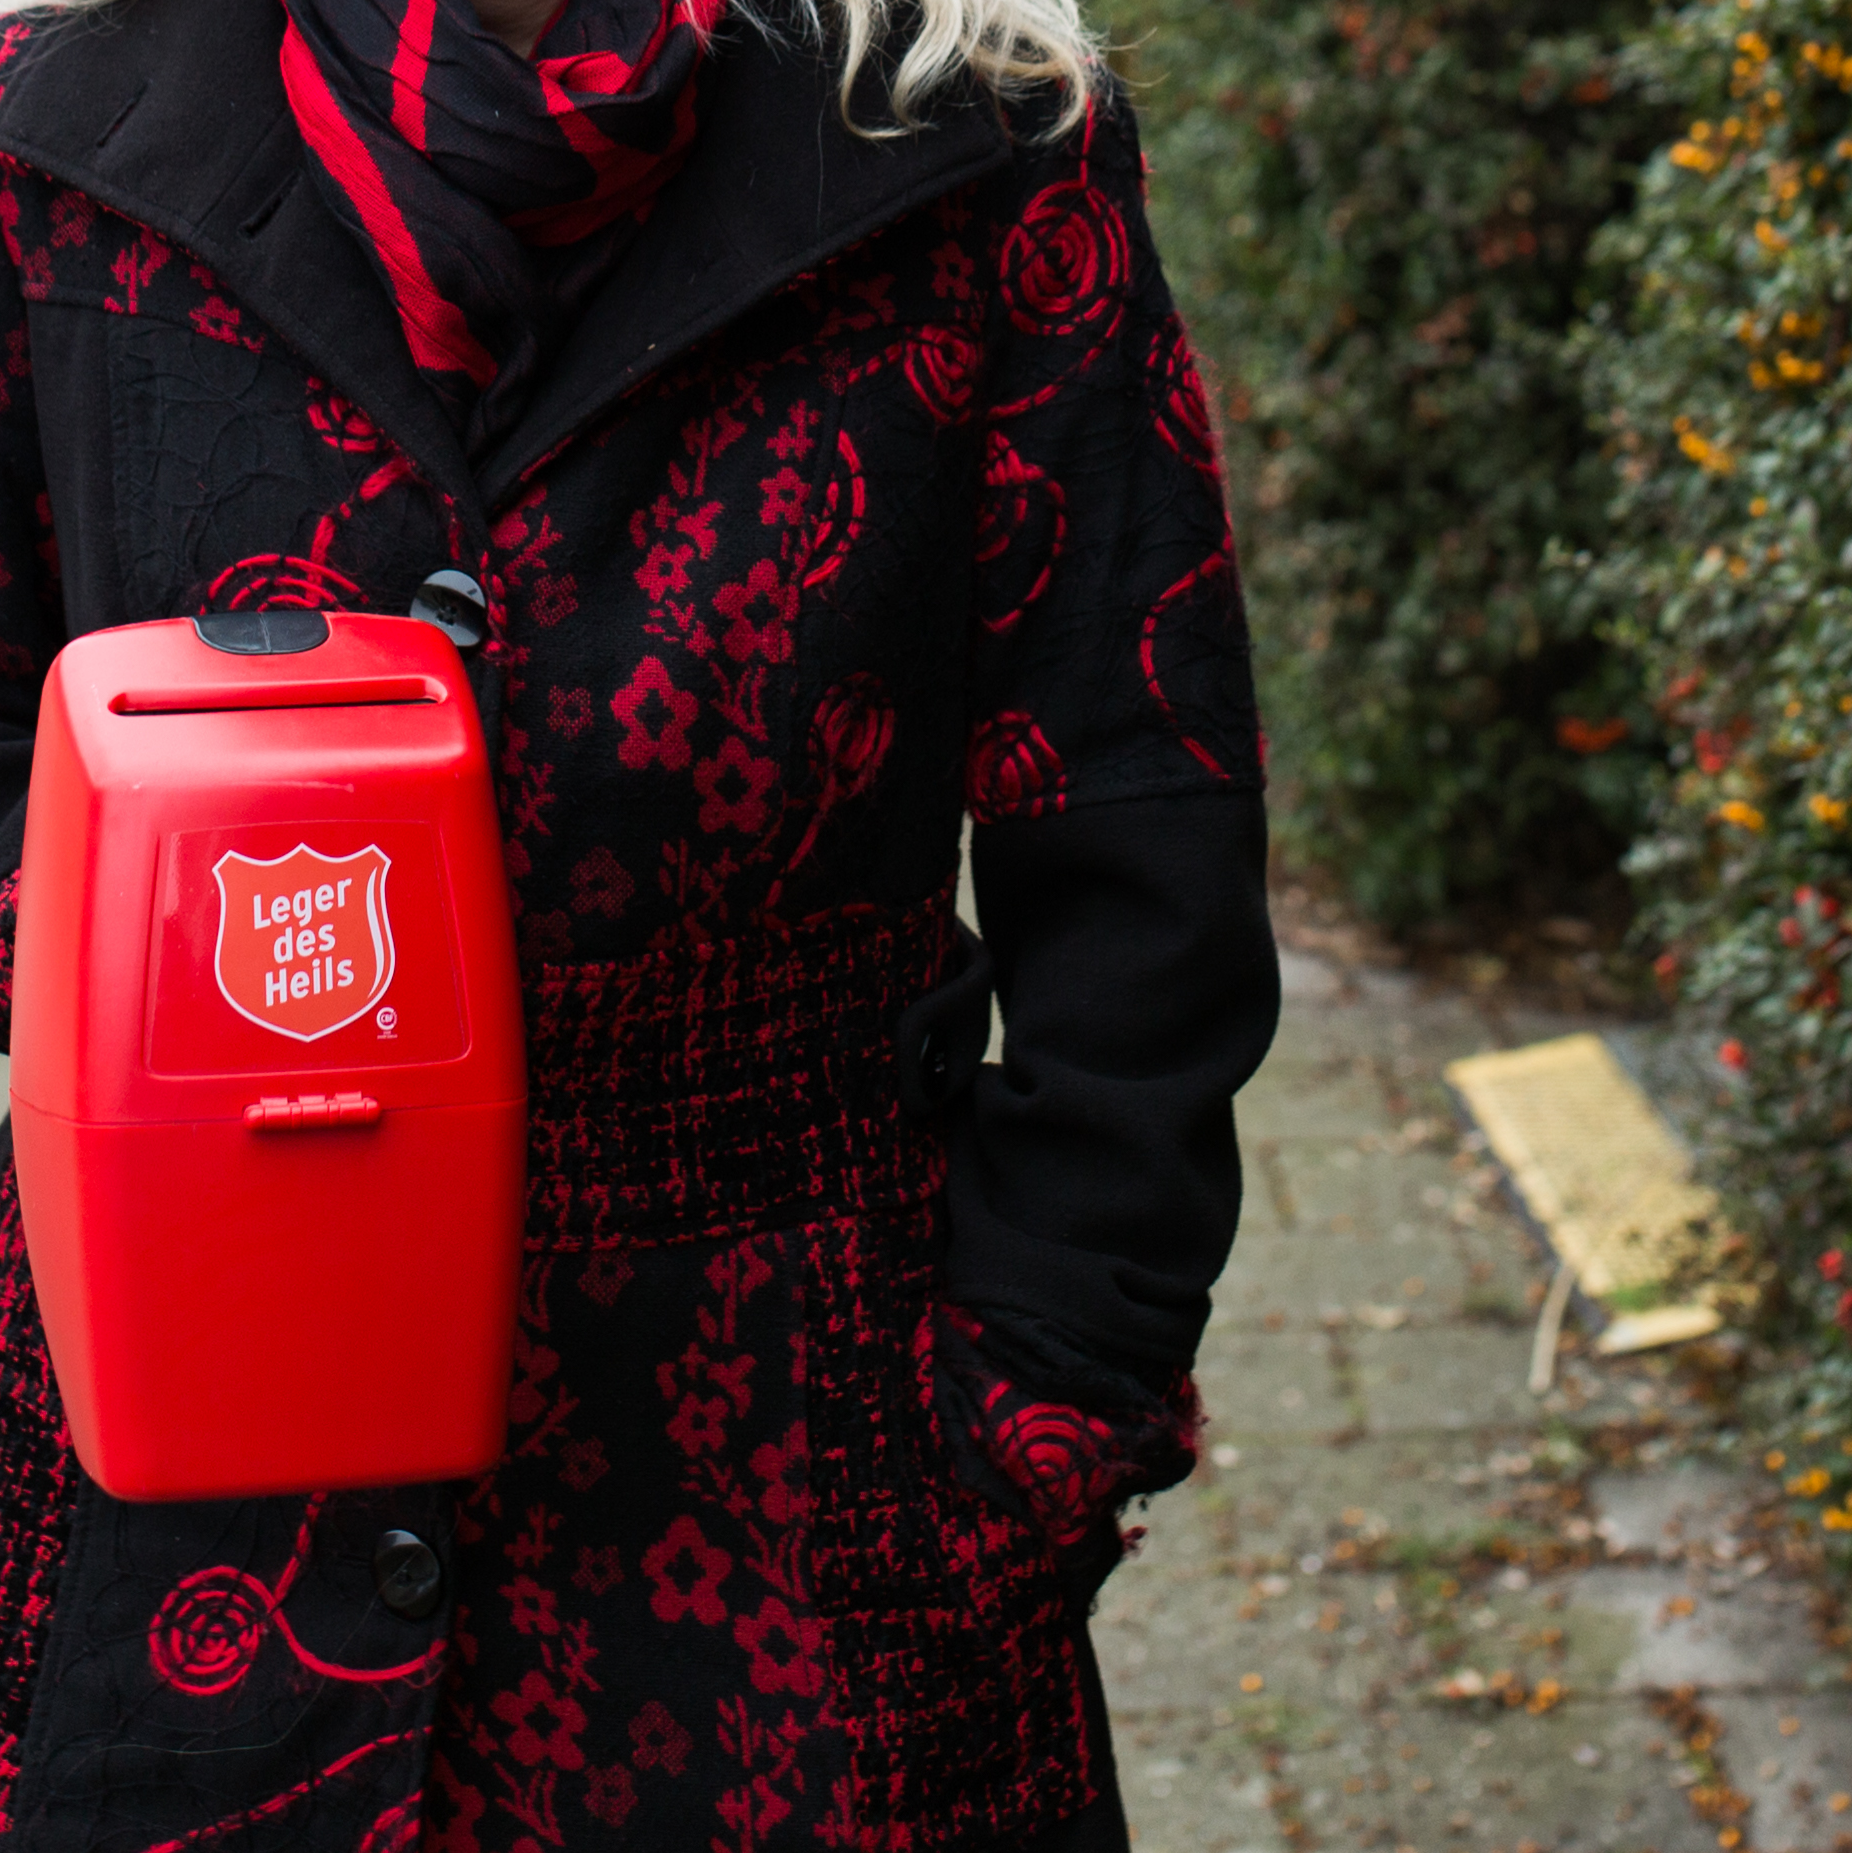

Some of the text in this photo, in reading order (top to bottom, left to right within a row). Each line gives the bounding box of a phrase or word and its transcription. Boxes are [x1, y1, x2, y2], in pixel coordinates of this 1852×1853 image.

[253, 878, 352, 930] Leger
[273, 923, 335, 963] des
[265, 955, 354, 1007] Heils
